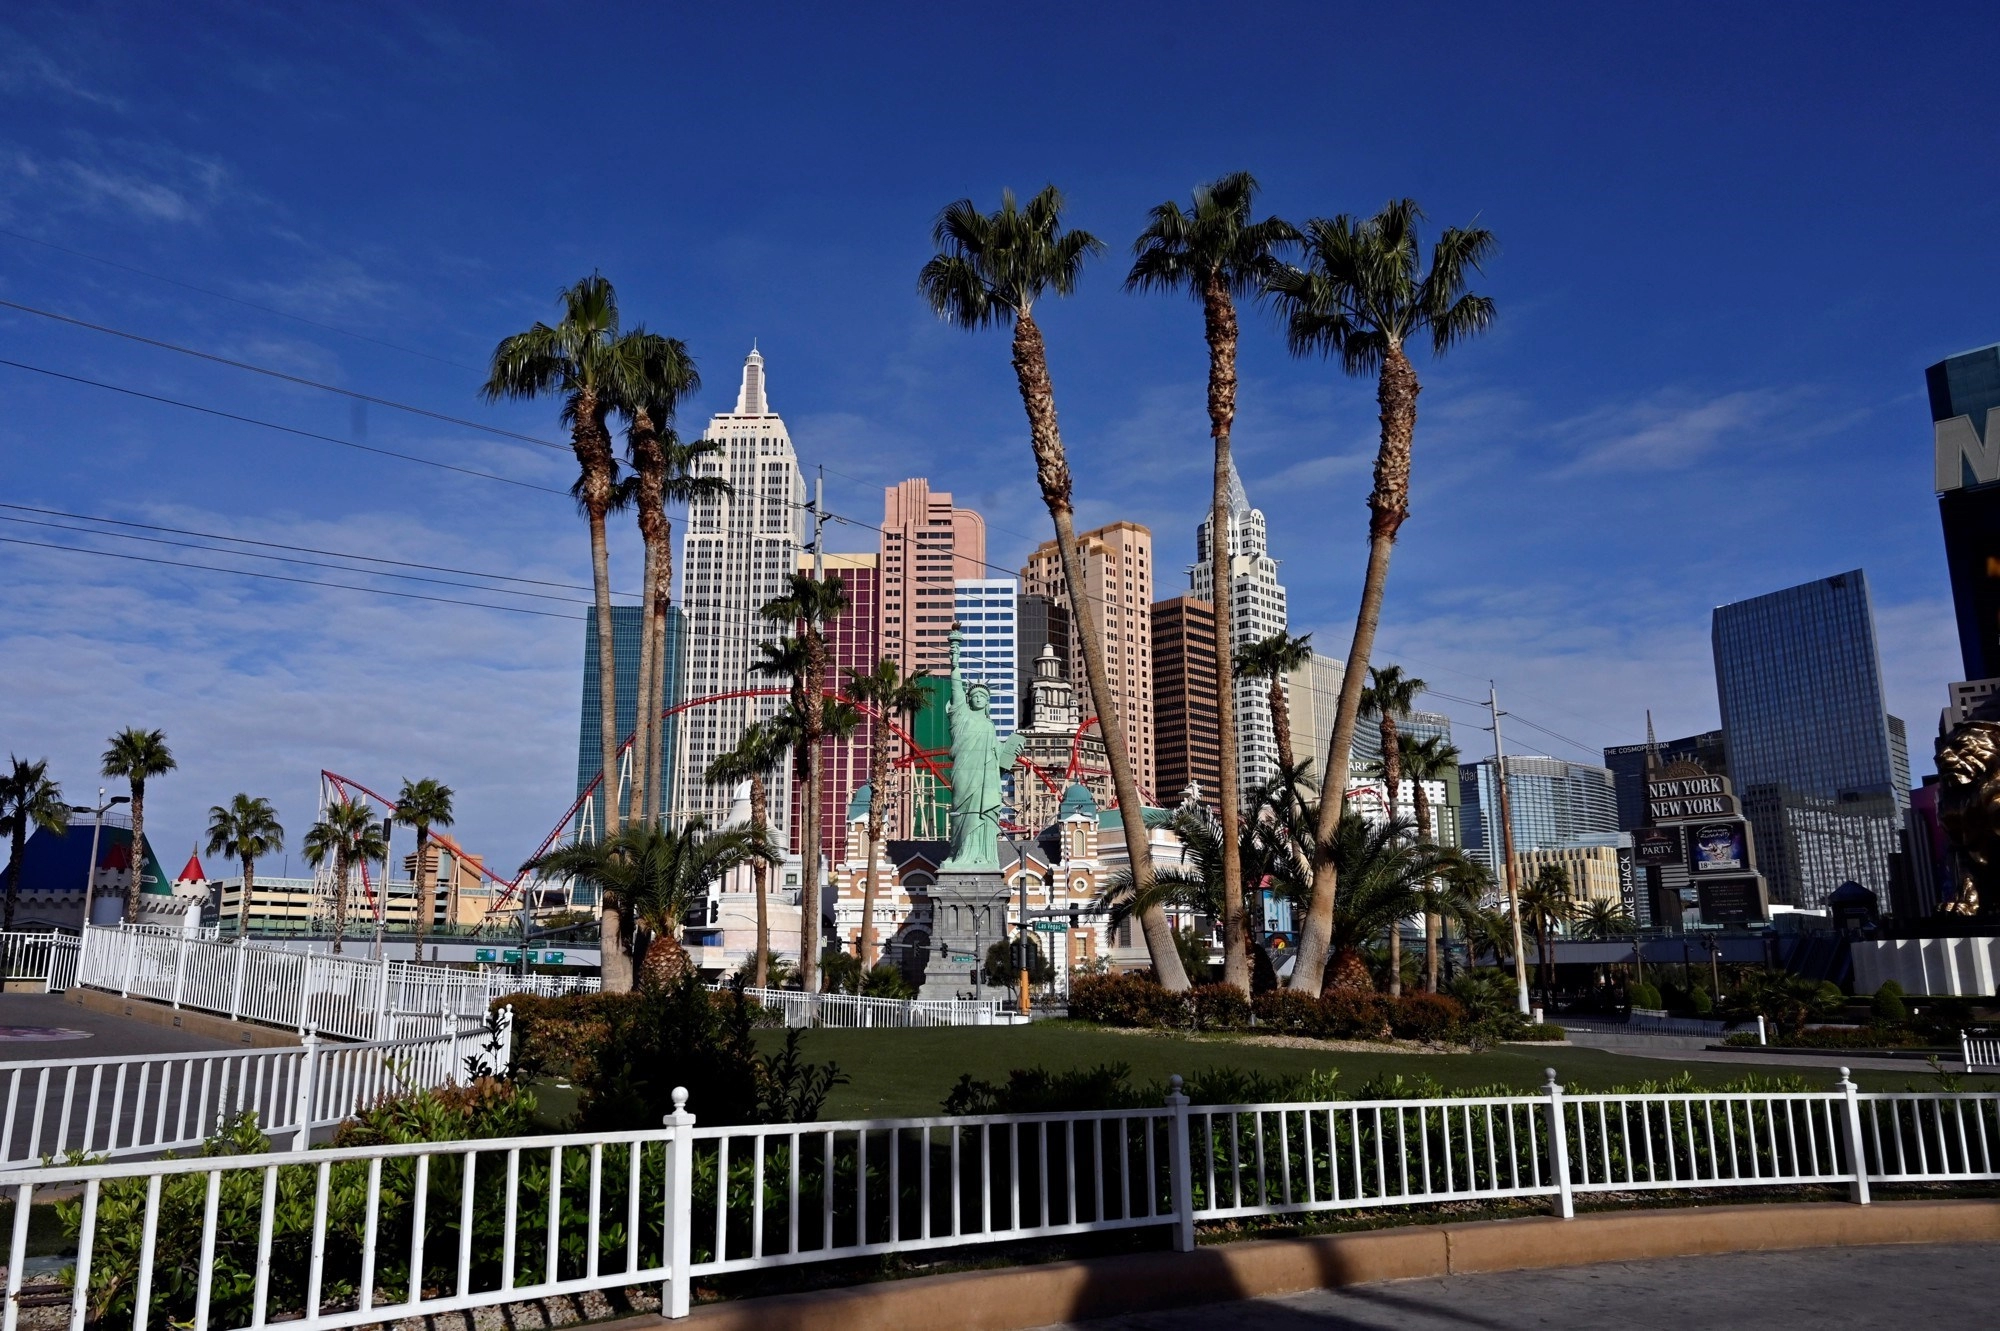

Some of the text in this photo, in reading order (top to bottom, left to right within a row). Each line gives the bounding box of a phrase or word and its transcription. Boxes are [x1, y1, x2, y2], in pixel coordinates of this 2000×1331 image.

[1618, 742, 1670, 754] COSMOPOLITAN
[1349, 761, 1369, 772] ARK
[1459, 769, 1477, 782] Vdar
[1649, 777, 1721, 798] NEW YORK
[1651, 797, 1724, 818] NEW YORK
[1642, 845, 1674, 855] PARTY.
[1620, 856, 1636, 919] AKE SHACK
[1047, 922, 1061, 931] Vegas
